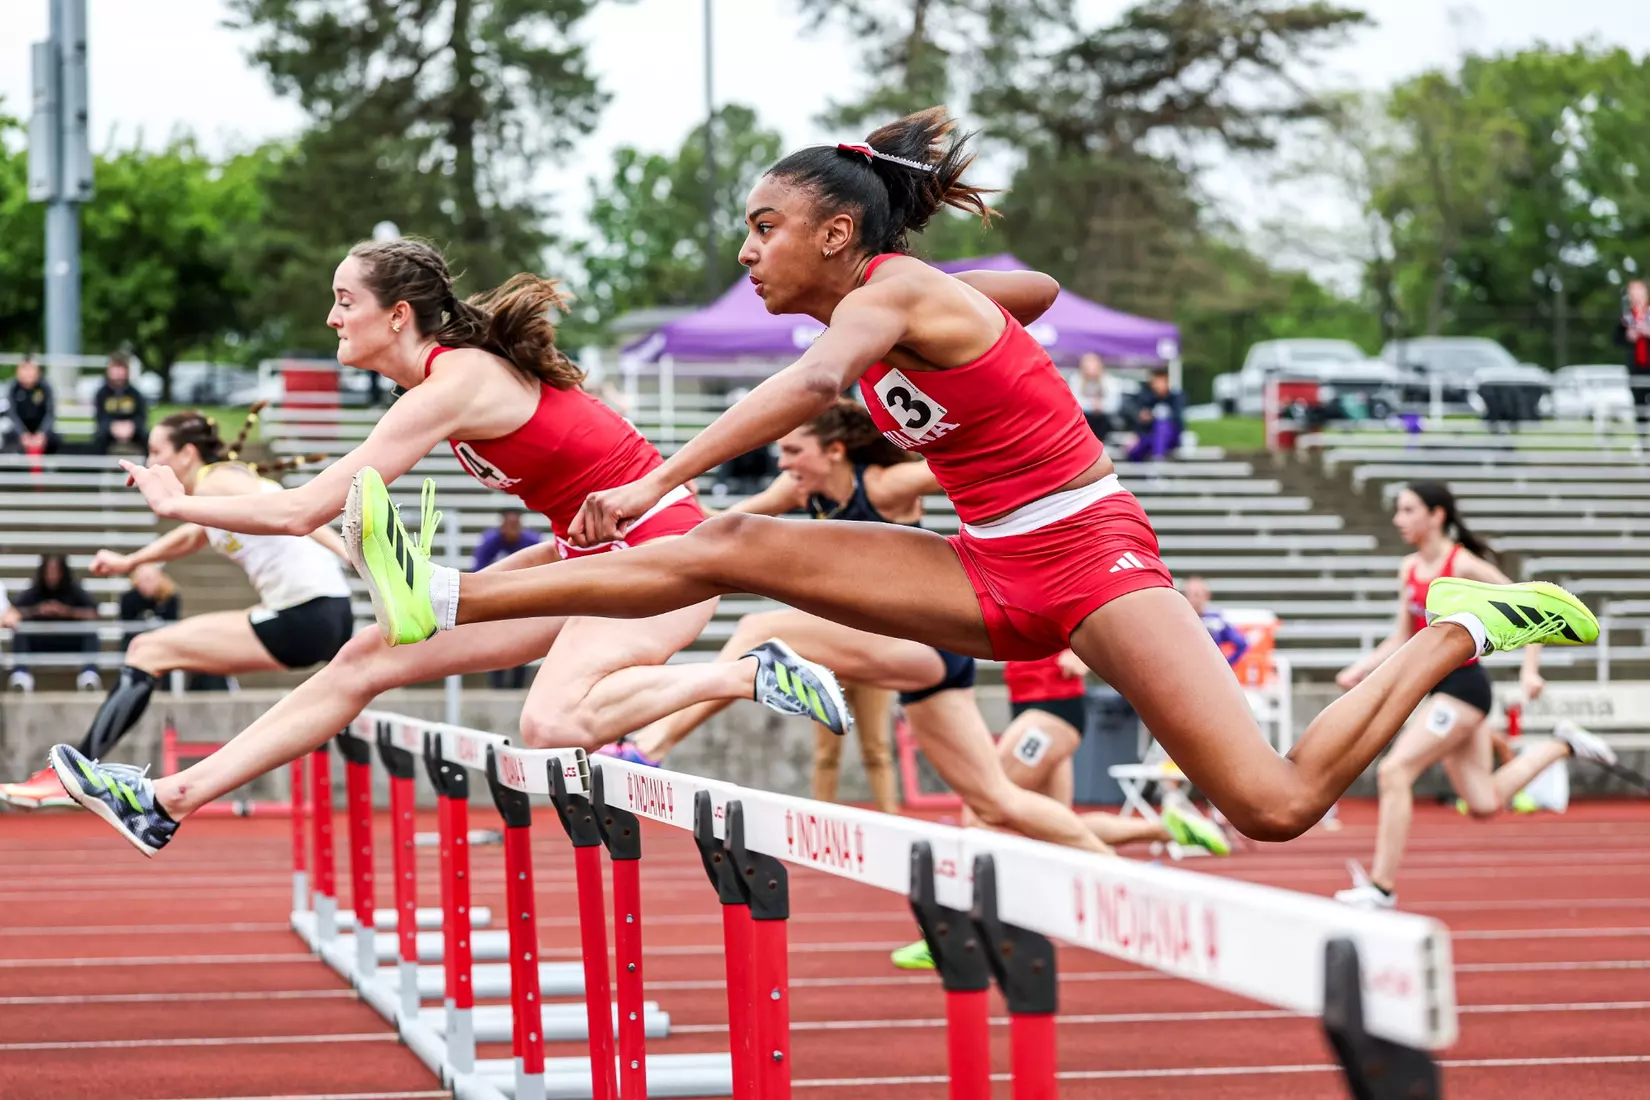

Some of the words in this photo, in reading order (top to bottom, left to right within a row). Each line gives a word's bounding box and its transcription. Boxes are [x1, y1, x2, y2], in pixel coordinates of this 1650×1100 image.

[886, 386, 932, 429] 3
[459, 447, 500, 481] 4
[633, 773, 667, 819] INDIANA
[796, 811, 853, 872] INDIANA
